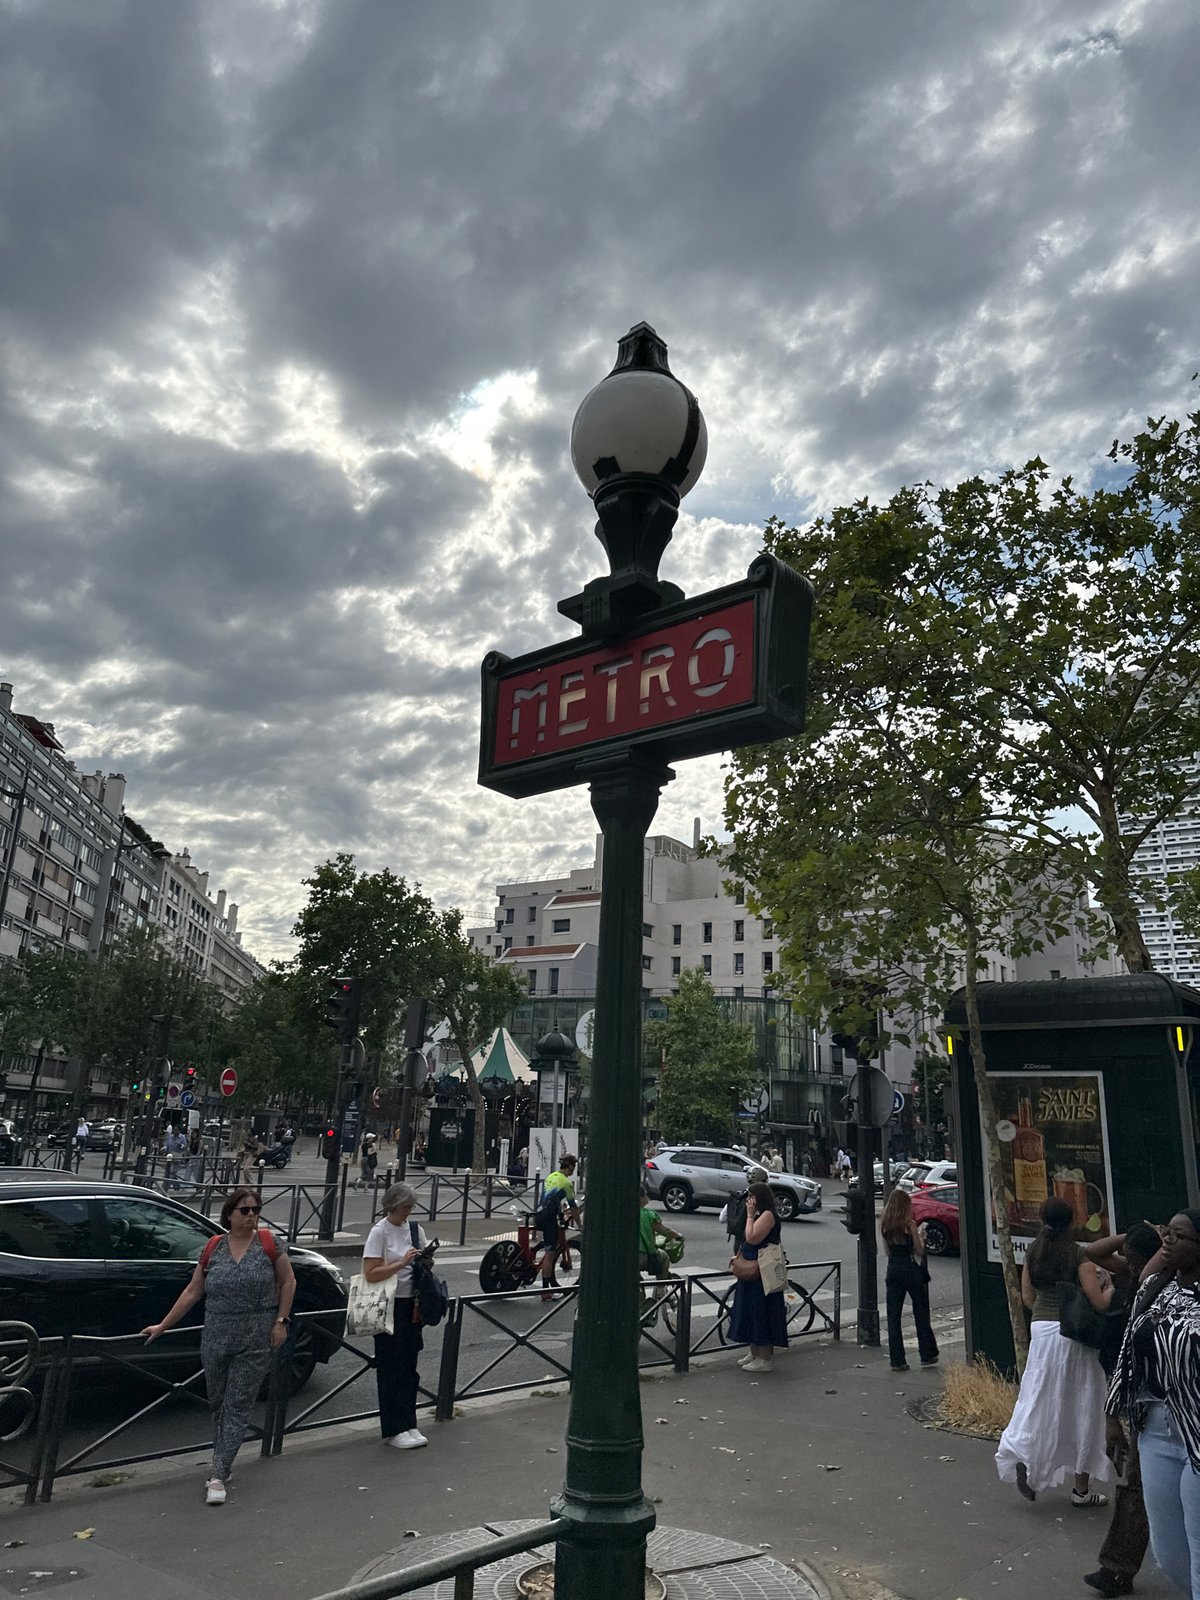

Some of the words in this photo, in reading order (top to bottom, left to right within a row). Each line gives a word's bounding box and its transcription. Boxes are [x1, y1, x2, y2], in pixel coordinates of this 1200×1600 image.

[510, 627, 735, 749] METRO
[1038, 1087, 1095, 1105] SAINT
[1036, 1104, 1097, 1121] JAMES
